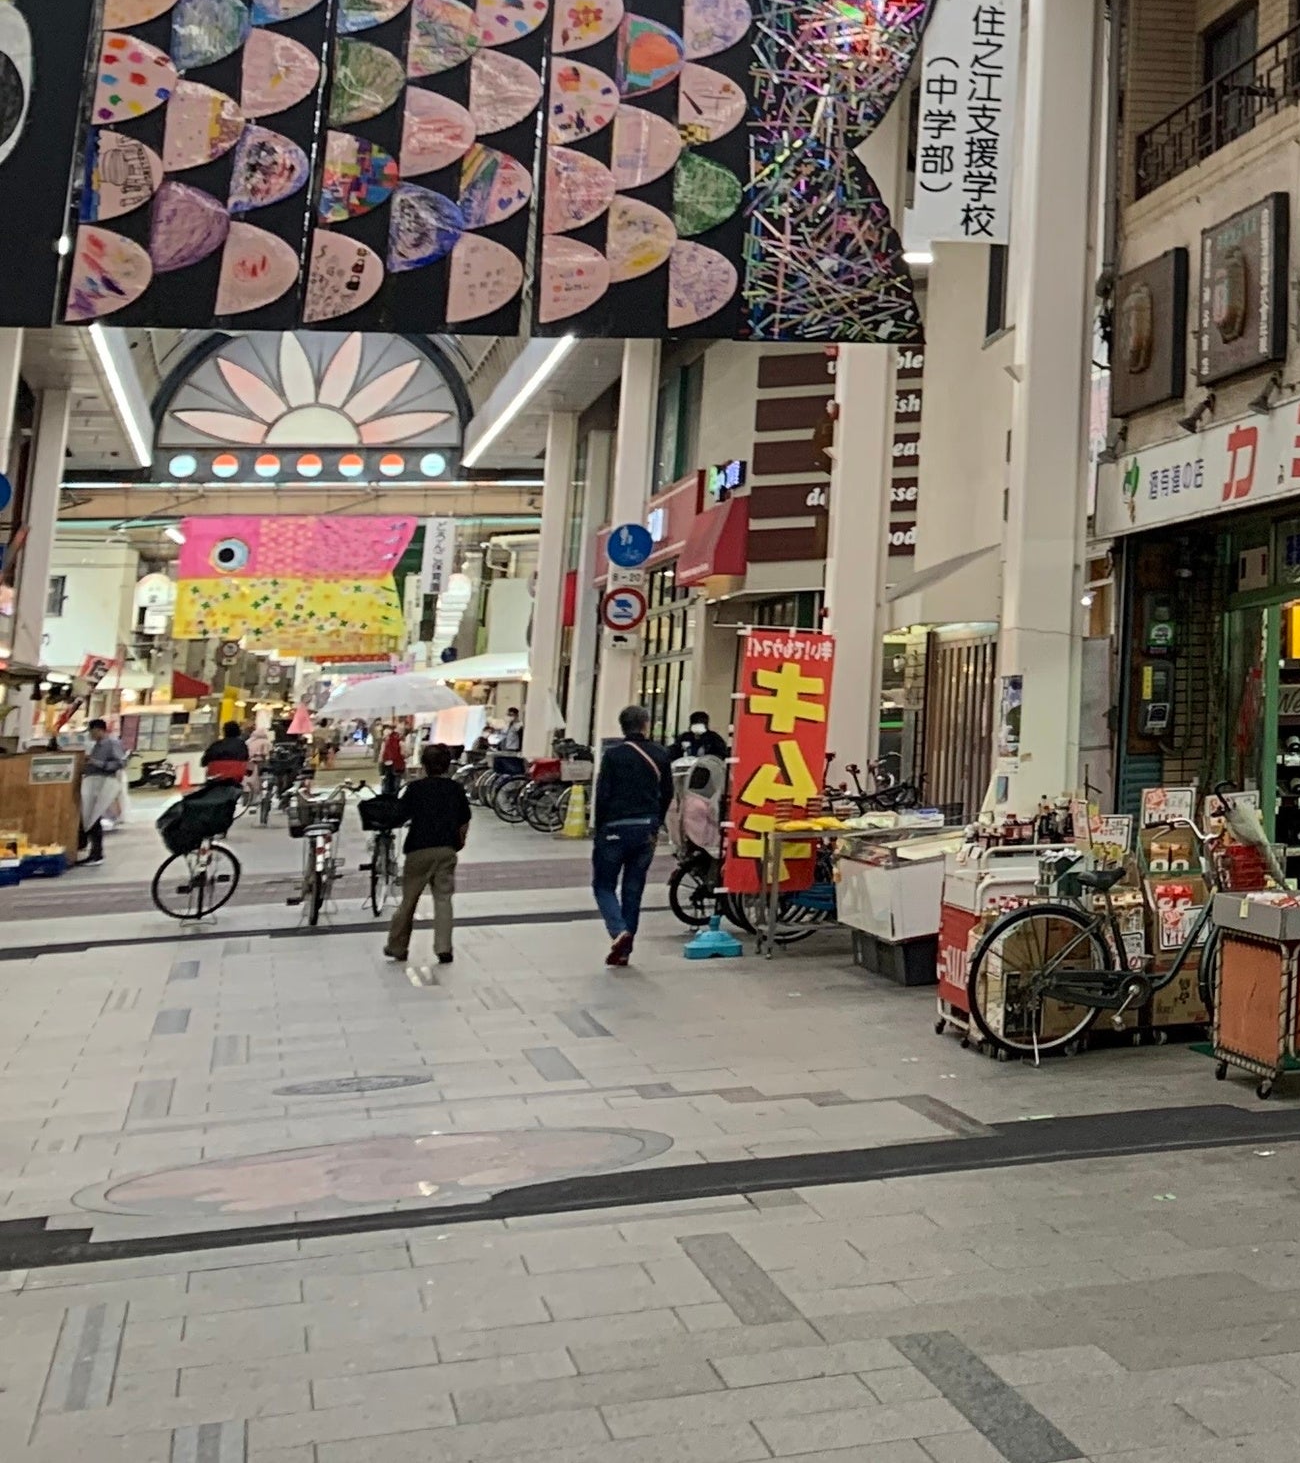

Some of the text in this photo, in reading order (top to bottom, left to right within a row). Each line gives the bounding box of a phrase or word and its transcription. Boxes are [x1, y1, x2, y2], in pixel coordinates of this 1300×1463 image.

[920, 55, 960, 194] (中学部)
[960, 5, 1006, 238] 住之江支援学校
